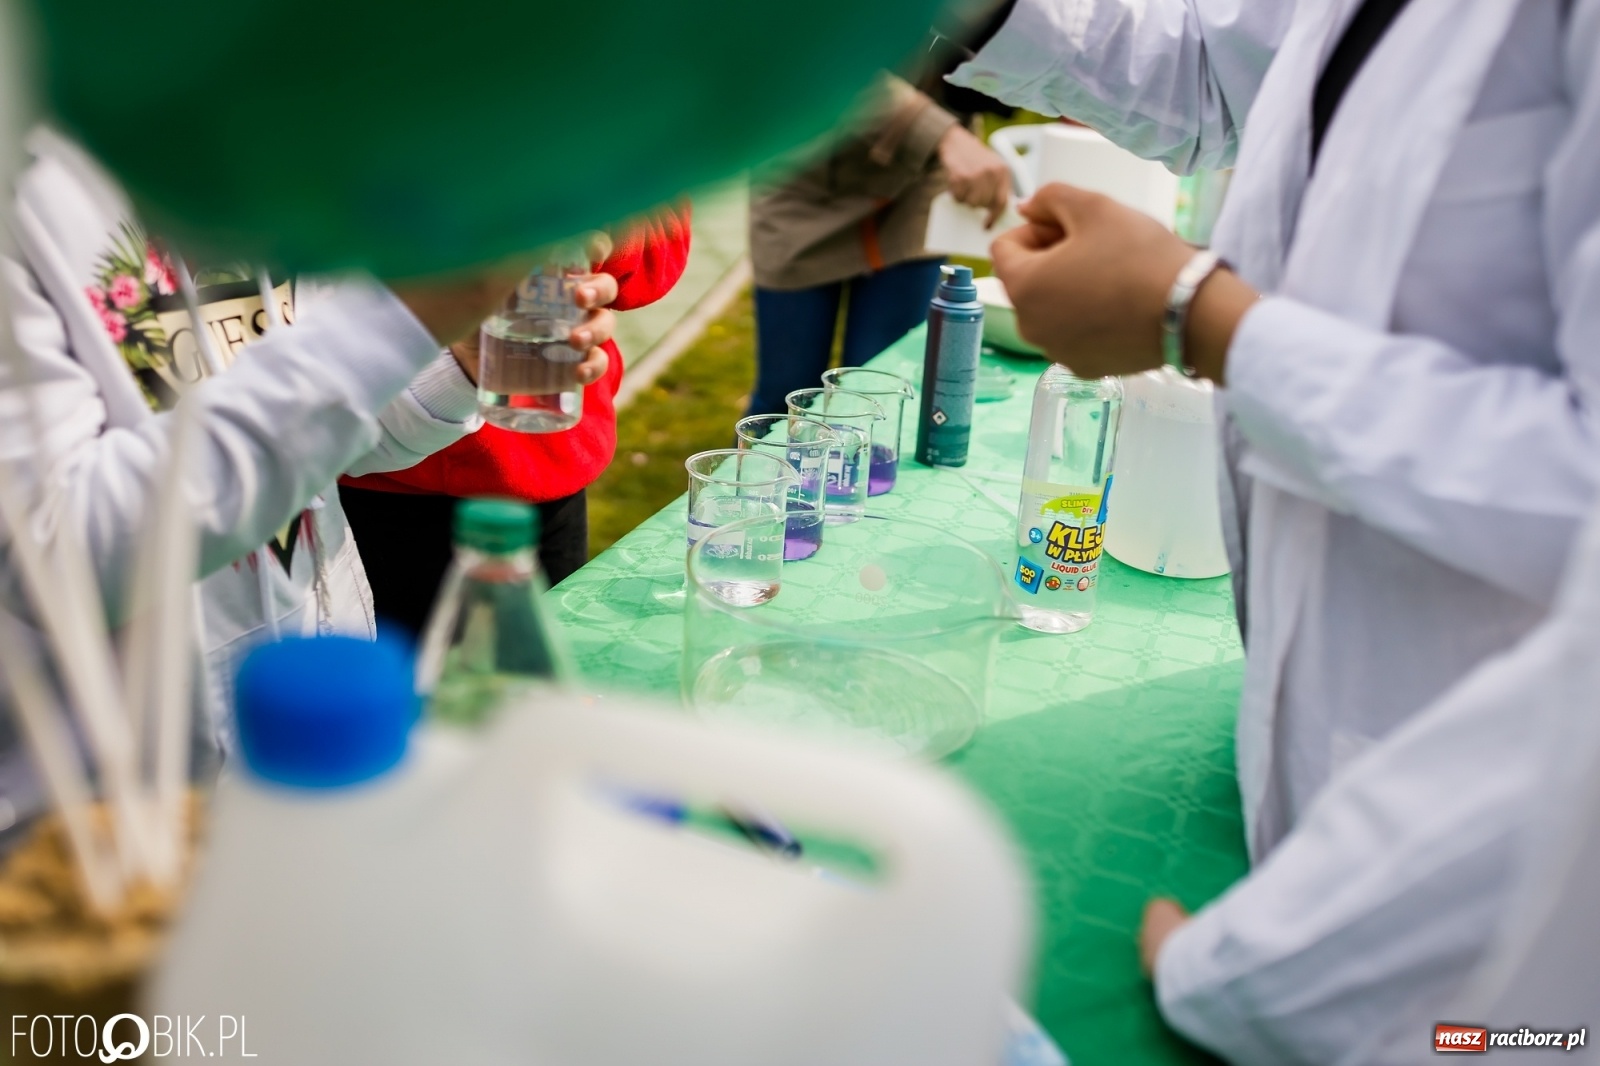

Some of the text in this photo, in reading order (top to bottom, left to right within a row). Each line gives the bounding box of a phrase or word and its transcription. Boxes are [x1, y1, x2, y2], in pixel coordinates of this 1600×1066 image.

[1061, 499, 1090, 508] SLIMY
[1030, 530, 1041, 540] 3+
[1048, 521, 1104, 549] KLEJ
[1047, 544, 1063, 559] W
[1020, 564, 1036, 578] 500
[1051, 562, 1097, 574] LIQUID GLUE
[1021, 576, 1032, 584] ml
